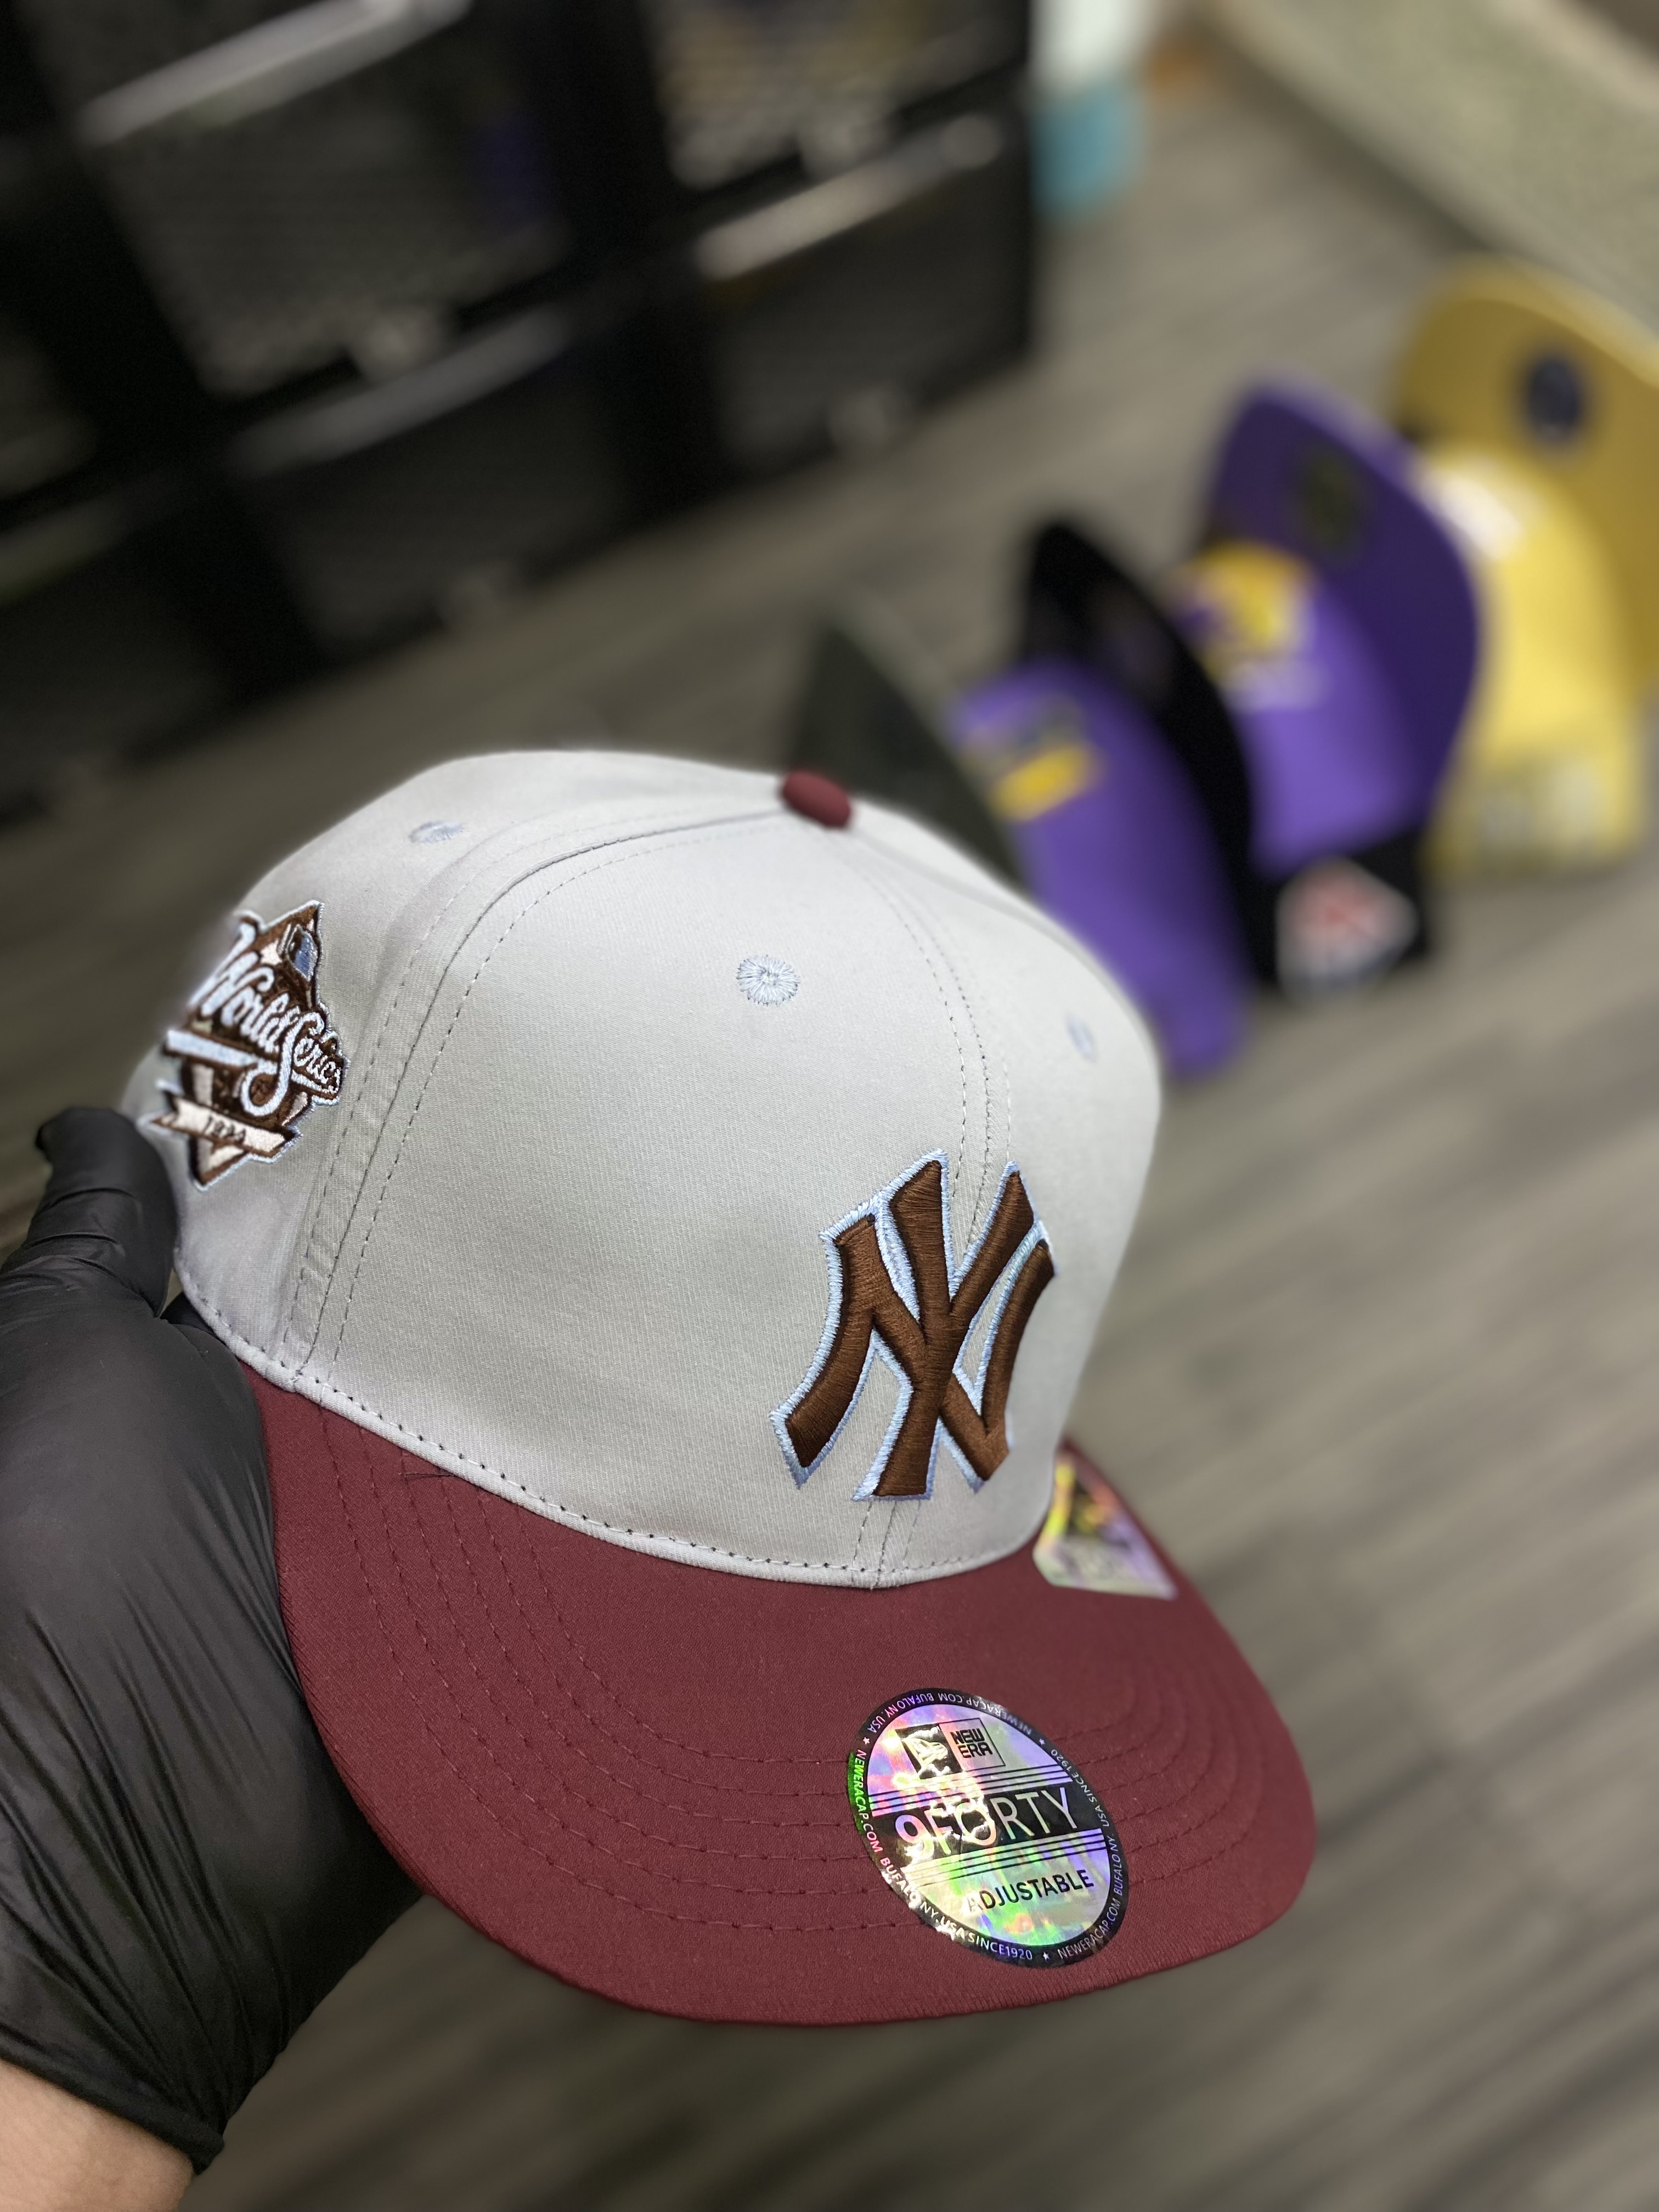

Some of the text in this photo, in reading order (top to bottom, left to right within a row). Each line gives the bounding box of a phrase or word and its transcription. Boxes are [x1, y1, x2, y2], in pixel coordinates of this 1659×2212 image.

[770, 1149, 1057, 1500] NY
[867, 1715, 886, 1734] USA
[950, 1728, 993, 1758] NEW ERA
[853, 1749, 883, 1853] NEWERACAP.COM
[895, 1786, 1078, 1860] 9FORTY
[967, 1869, 1094, 1912] ADJUSTABLE
[1057, 1897, 1121, 1960] NEWERACAP.COM
[1094, 1804, 1110, 1827] USA
